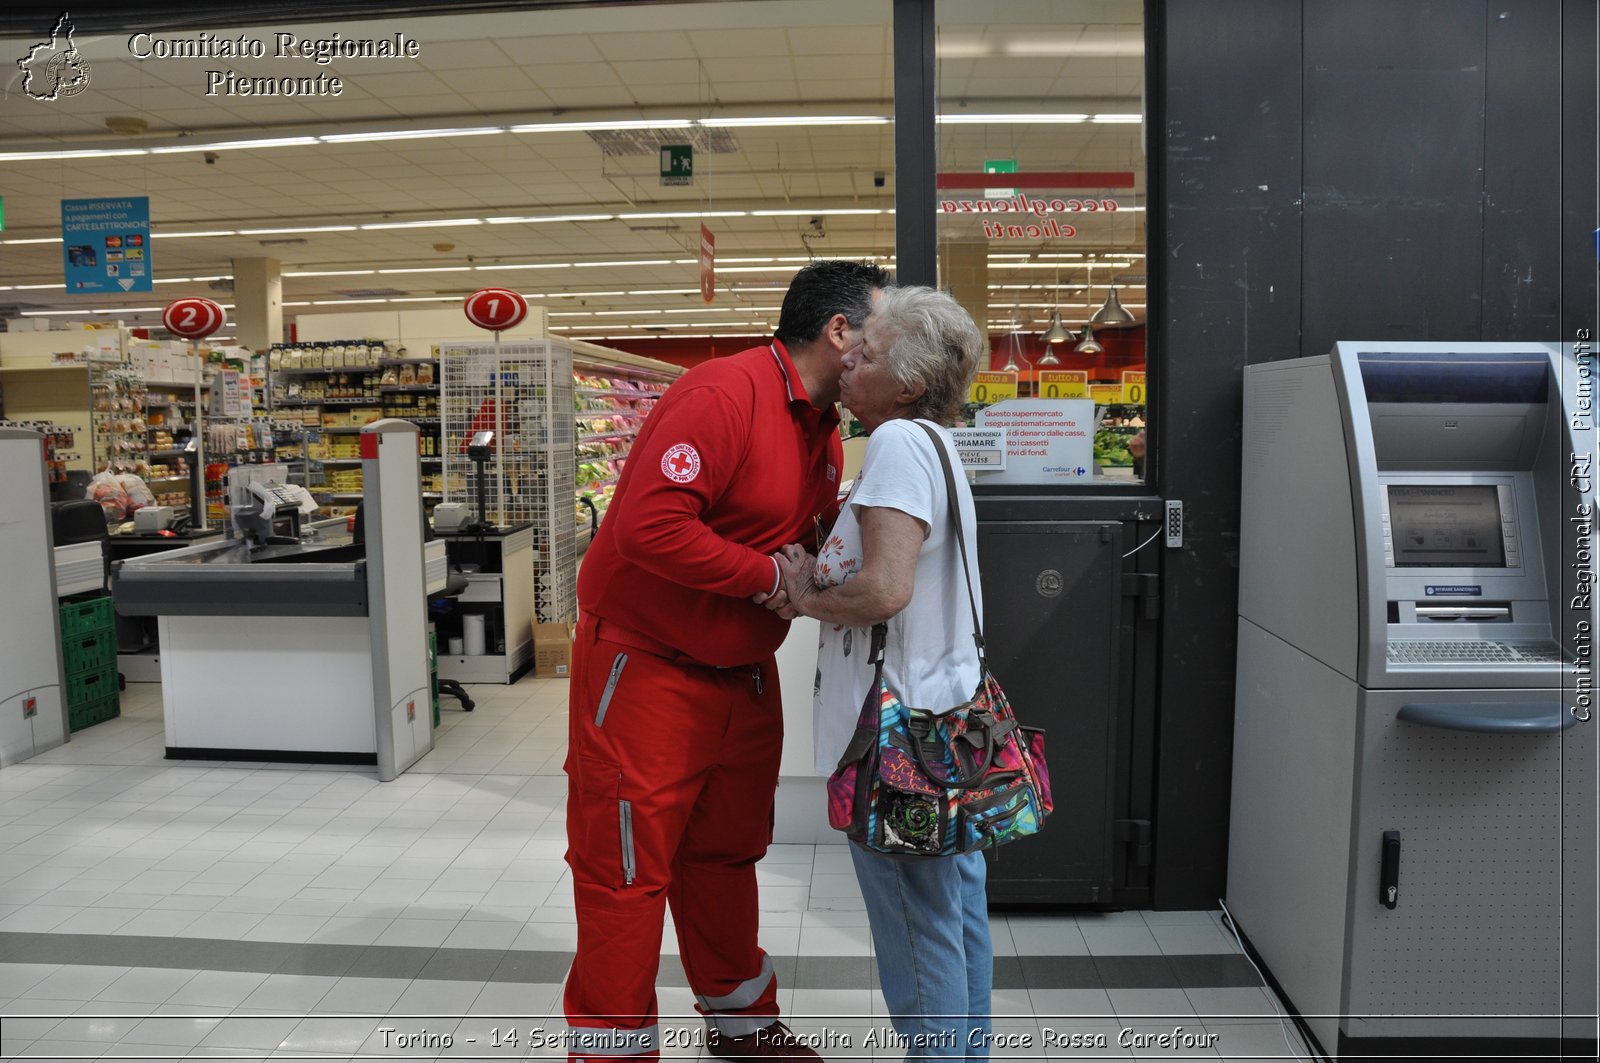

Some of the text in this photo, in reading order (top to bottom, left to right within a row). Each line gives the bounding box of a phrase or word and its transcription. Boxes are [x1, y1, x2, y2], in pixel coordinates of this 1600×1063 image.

[88, 201, 132, 210] RISERVATA
[71, 212, 112, 222] pagamenti
[65, 220, 148, 231] CARTE ELETTRONICHE
[487, 298, 500, 319] 1
[179, 306, 197, 327] 2
[977, 374, 1000, 382] tutto
[1048, 373, 1071, 382] tutto
[1012, 410, 1063, 419] supermercato
